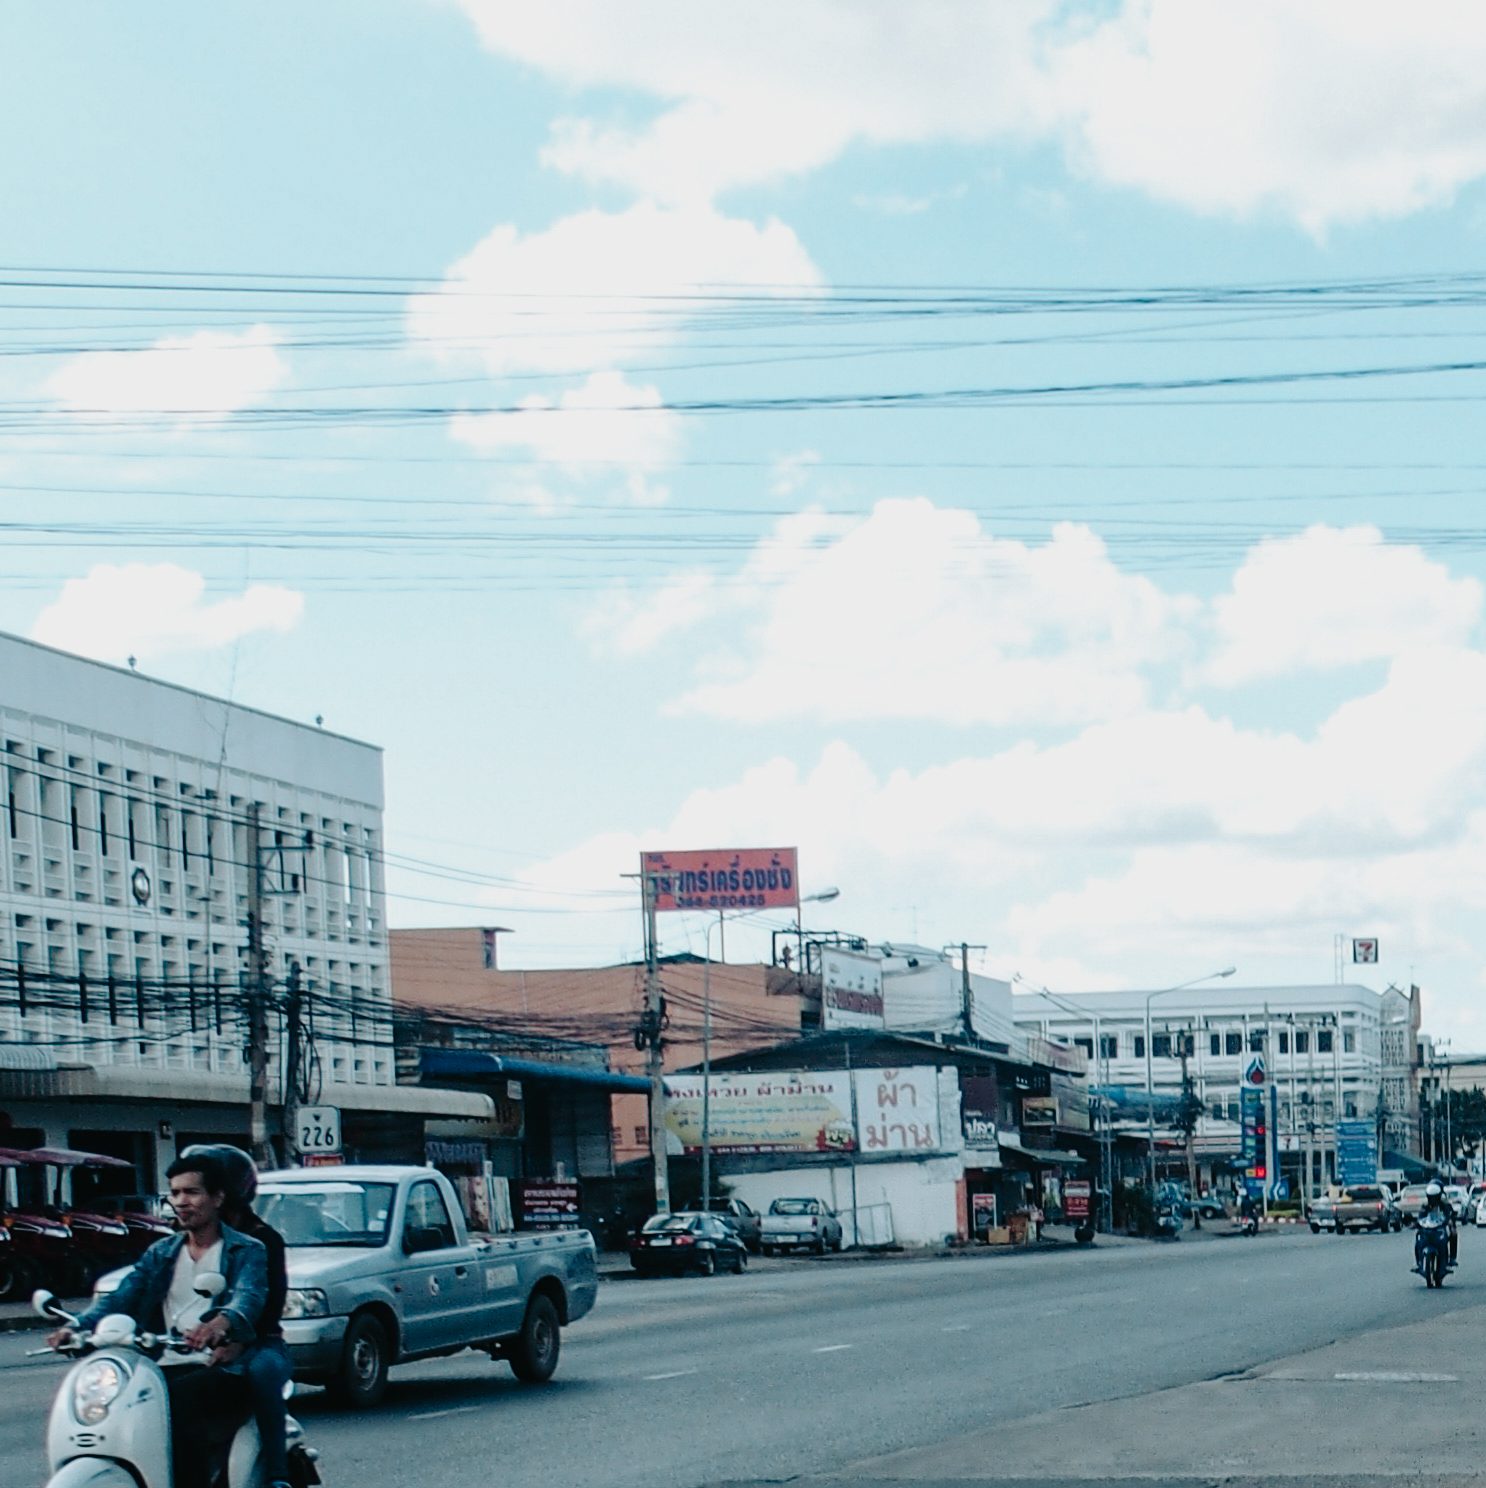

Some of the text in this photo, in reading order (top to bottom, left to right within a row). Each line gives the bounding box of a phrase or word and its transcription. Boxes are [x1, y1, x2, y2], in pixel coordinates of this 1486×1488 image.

[876, 1069, 917, 1108] ผ้า
[303, 1126, 334, 1147] 226
[866, 1113, 934, 1148] ม่าน
